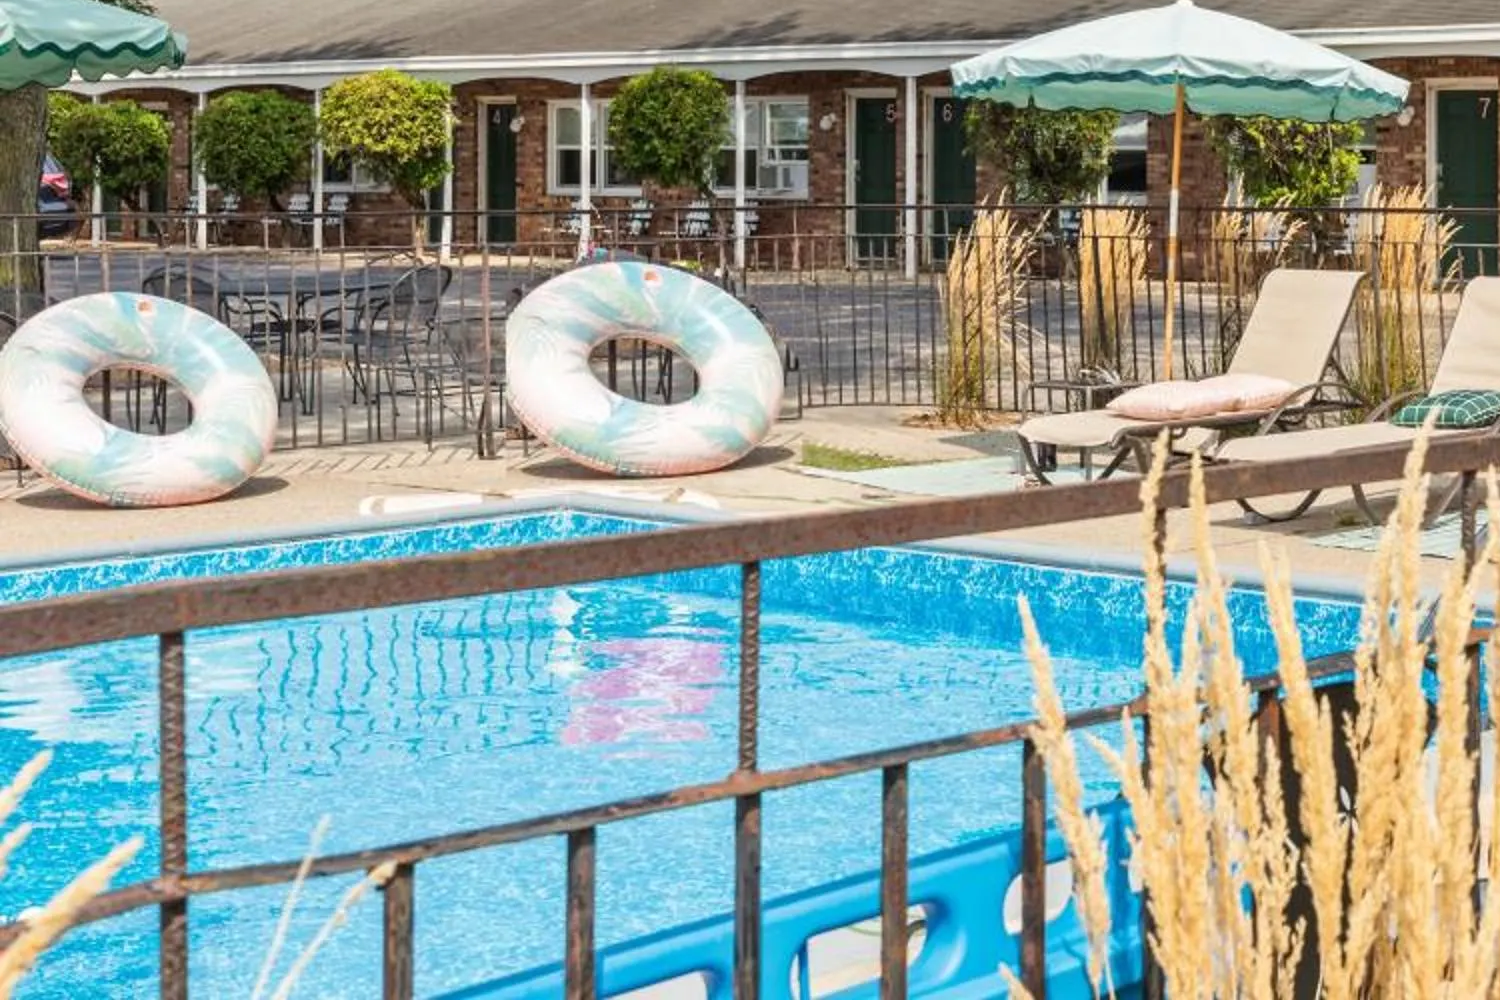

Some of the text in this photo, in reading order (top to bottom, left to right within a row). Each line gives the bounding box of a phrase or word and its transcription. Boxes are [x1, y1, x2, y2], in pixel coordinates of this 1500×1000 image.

[492, 110, 501, 124] 4
[886, 103, 898, 122] 5
[943, 103, 953, 122] 6
[1479, 97, 1491, 119] 7
